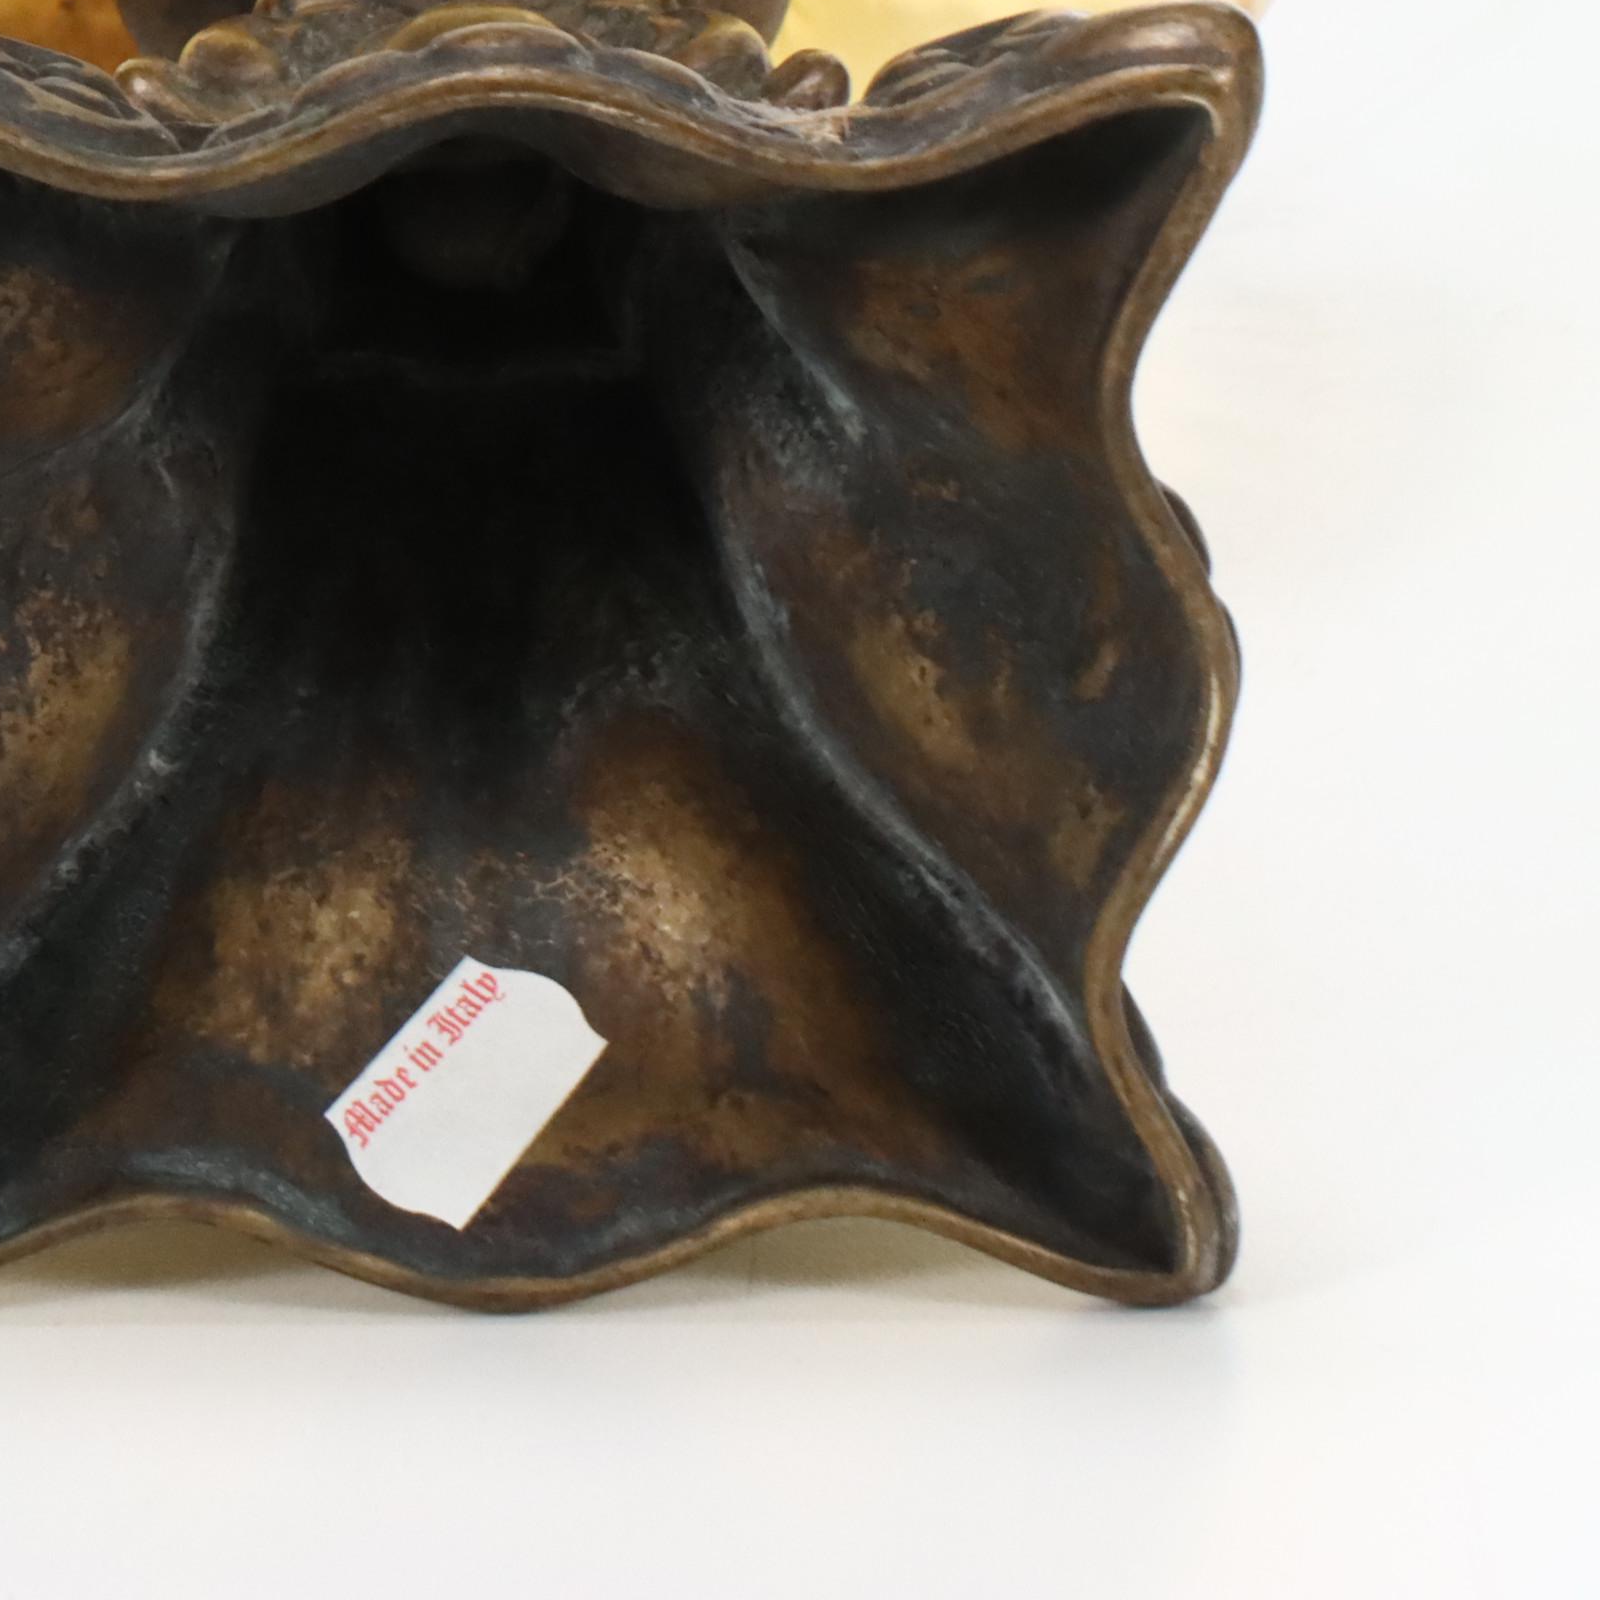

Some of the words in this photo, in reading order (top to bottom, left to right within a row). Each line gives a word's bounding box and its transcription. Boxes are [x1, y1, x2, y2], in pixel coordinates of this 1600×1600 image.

[343, 1067, 419, 1150] Made
[403, 1040, 444, 1072] in
[427, 971, 507, 1046] Italy
